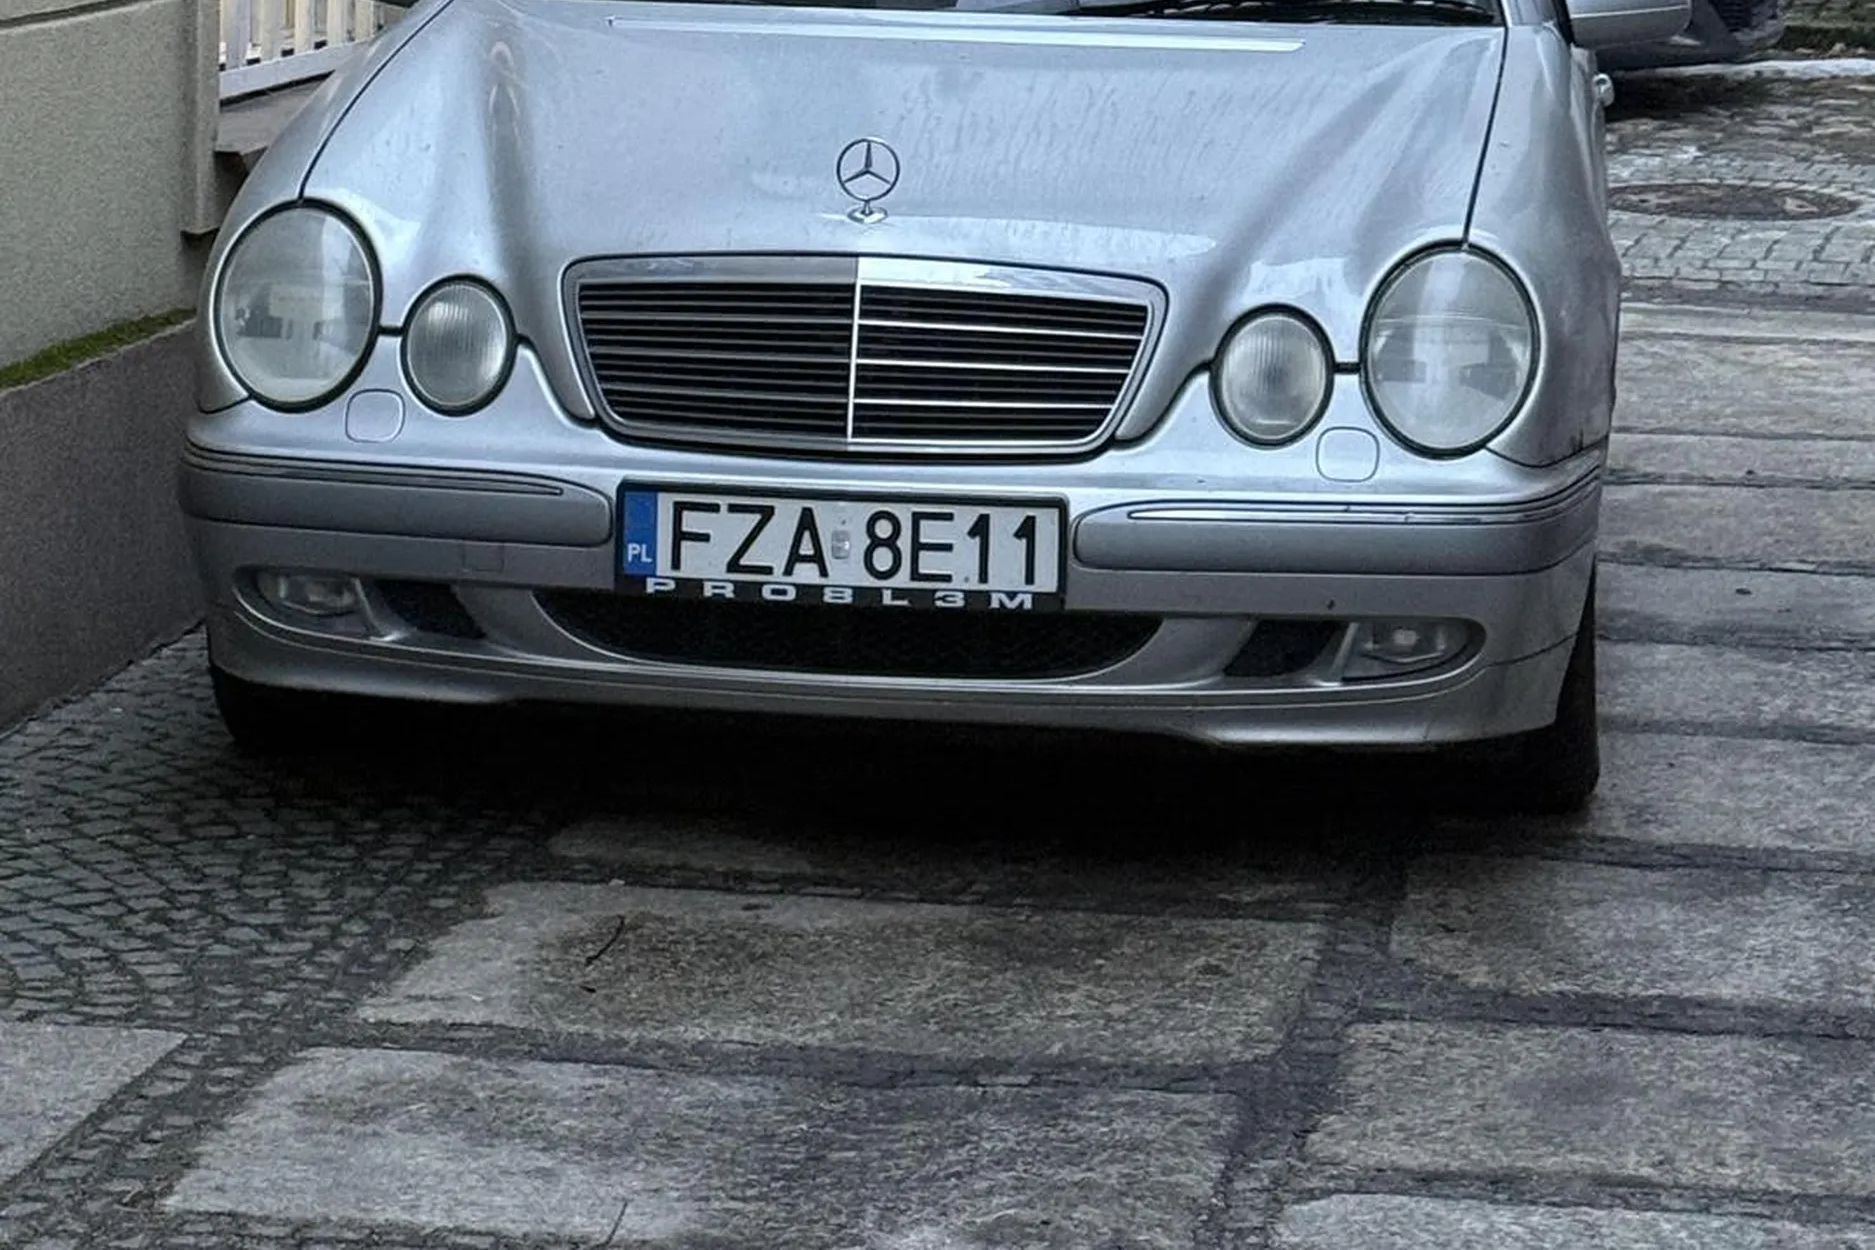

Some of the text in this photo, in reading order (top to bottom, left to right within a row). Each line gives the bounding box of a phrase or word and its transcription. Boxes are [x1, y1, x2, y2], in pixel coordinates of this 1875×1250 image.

[627, 543, 652, 563] PL
[671, 501, 1036, 585] FZA 8E11
